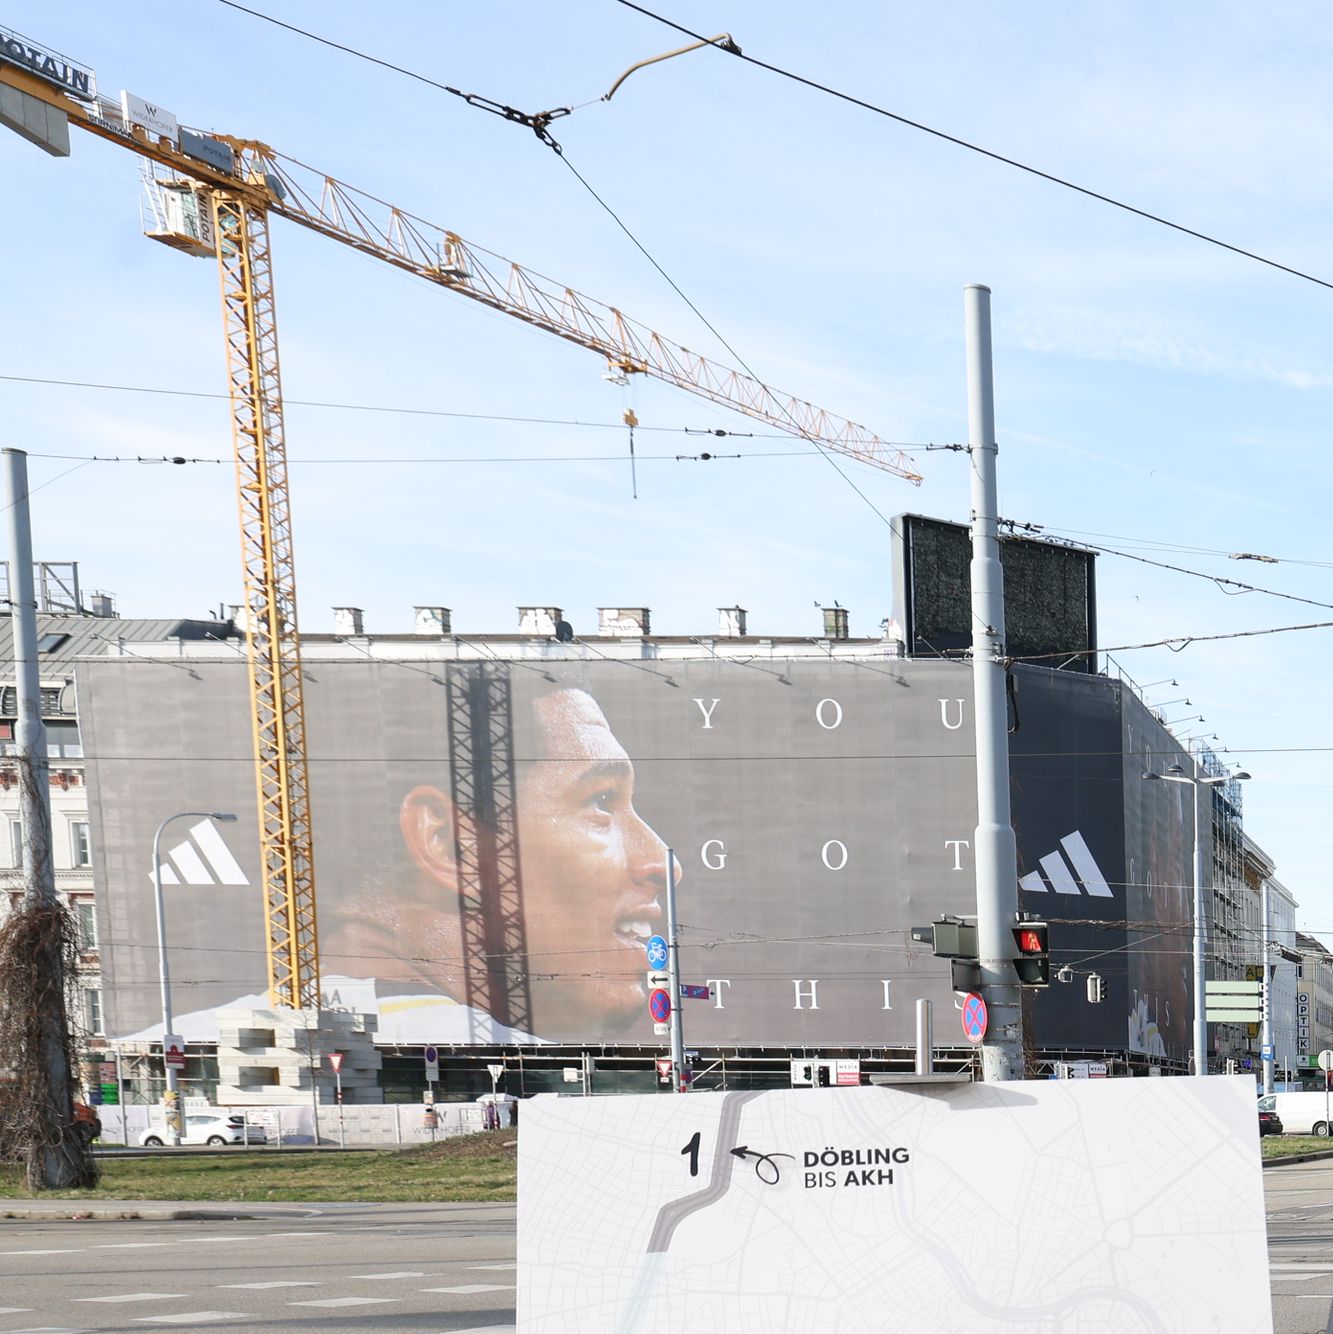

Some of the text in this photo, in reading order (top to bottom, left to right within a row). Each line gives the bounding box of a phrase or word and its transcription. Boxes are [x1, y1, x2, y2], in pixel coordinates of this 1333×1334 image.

[0, 33, 89, 93] OTAIN
[199, 190, 211, 243] POTAIN
[1299, 994, 1308, 1048] OPTIK
[681, 1132, 701, 1176] 1
[803, 1146, 910, 1168] DÖBLING
[804, 1169, 894, 1188] BIS AKH
